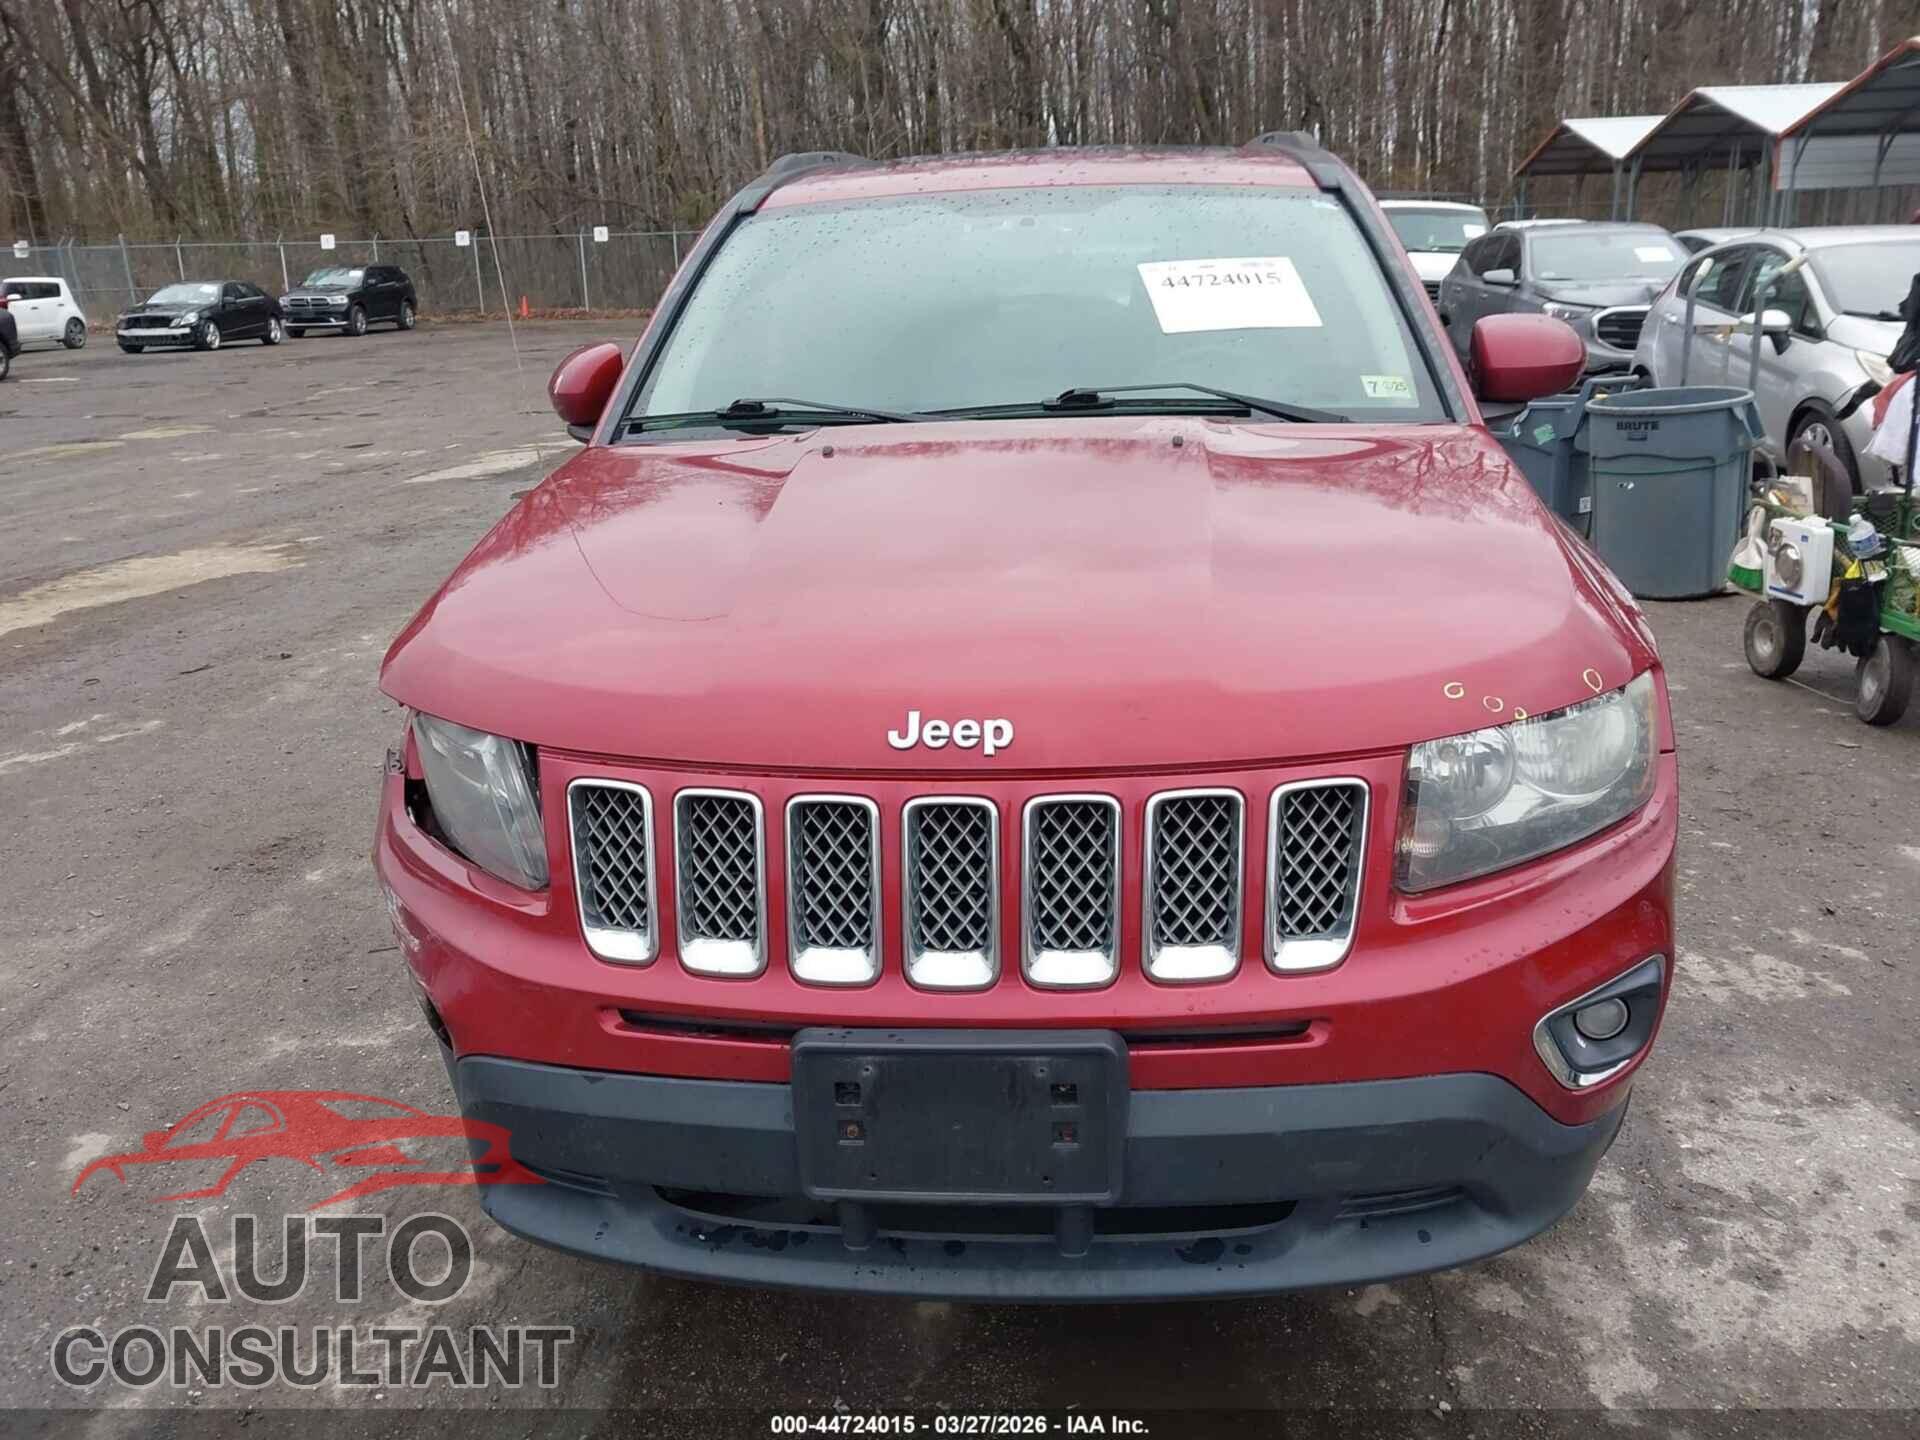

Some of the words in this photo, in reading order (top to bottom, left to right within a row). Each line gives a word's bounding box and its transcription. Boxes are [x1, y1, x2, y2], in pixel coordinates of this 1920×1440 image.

[1161, 271, 1282, 289] 44724015
[1616, 420, 1660, 431] BRUTE
[887, 710, 1014, 756] Jeep
